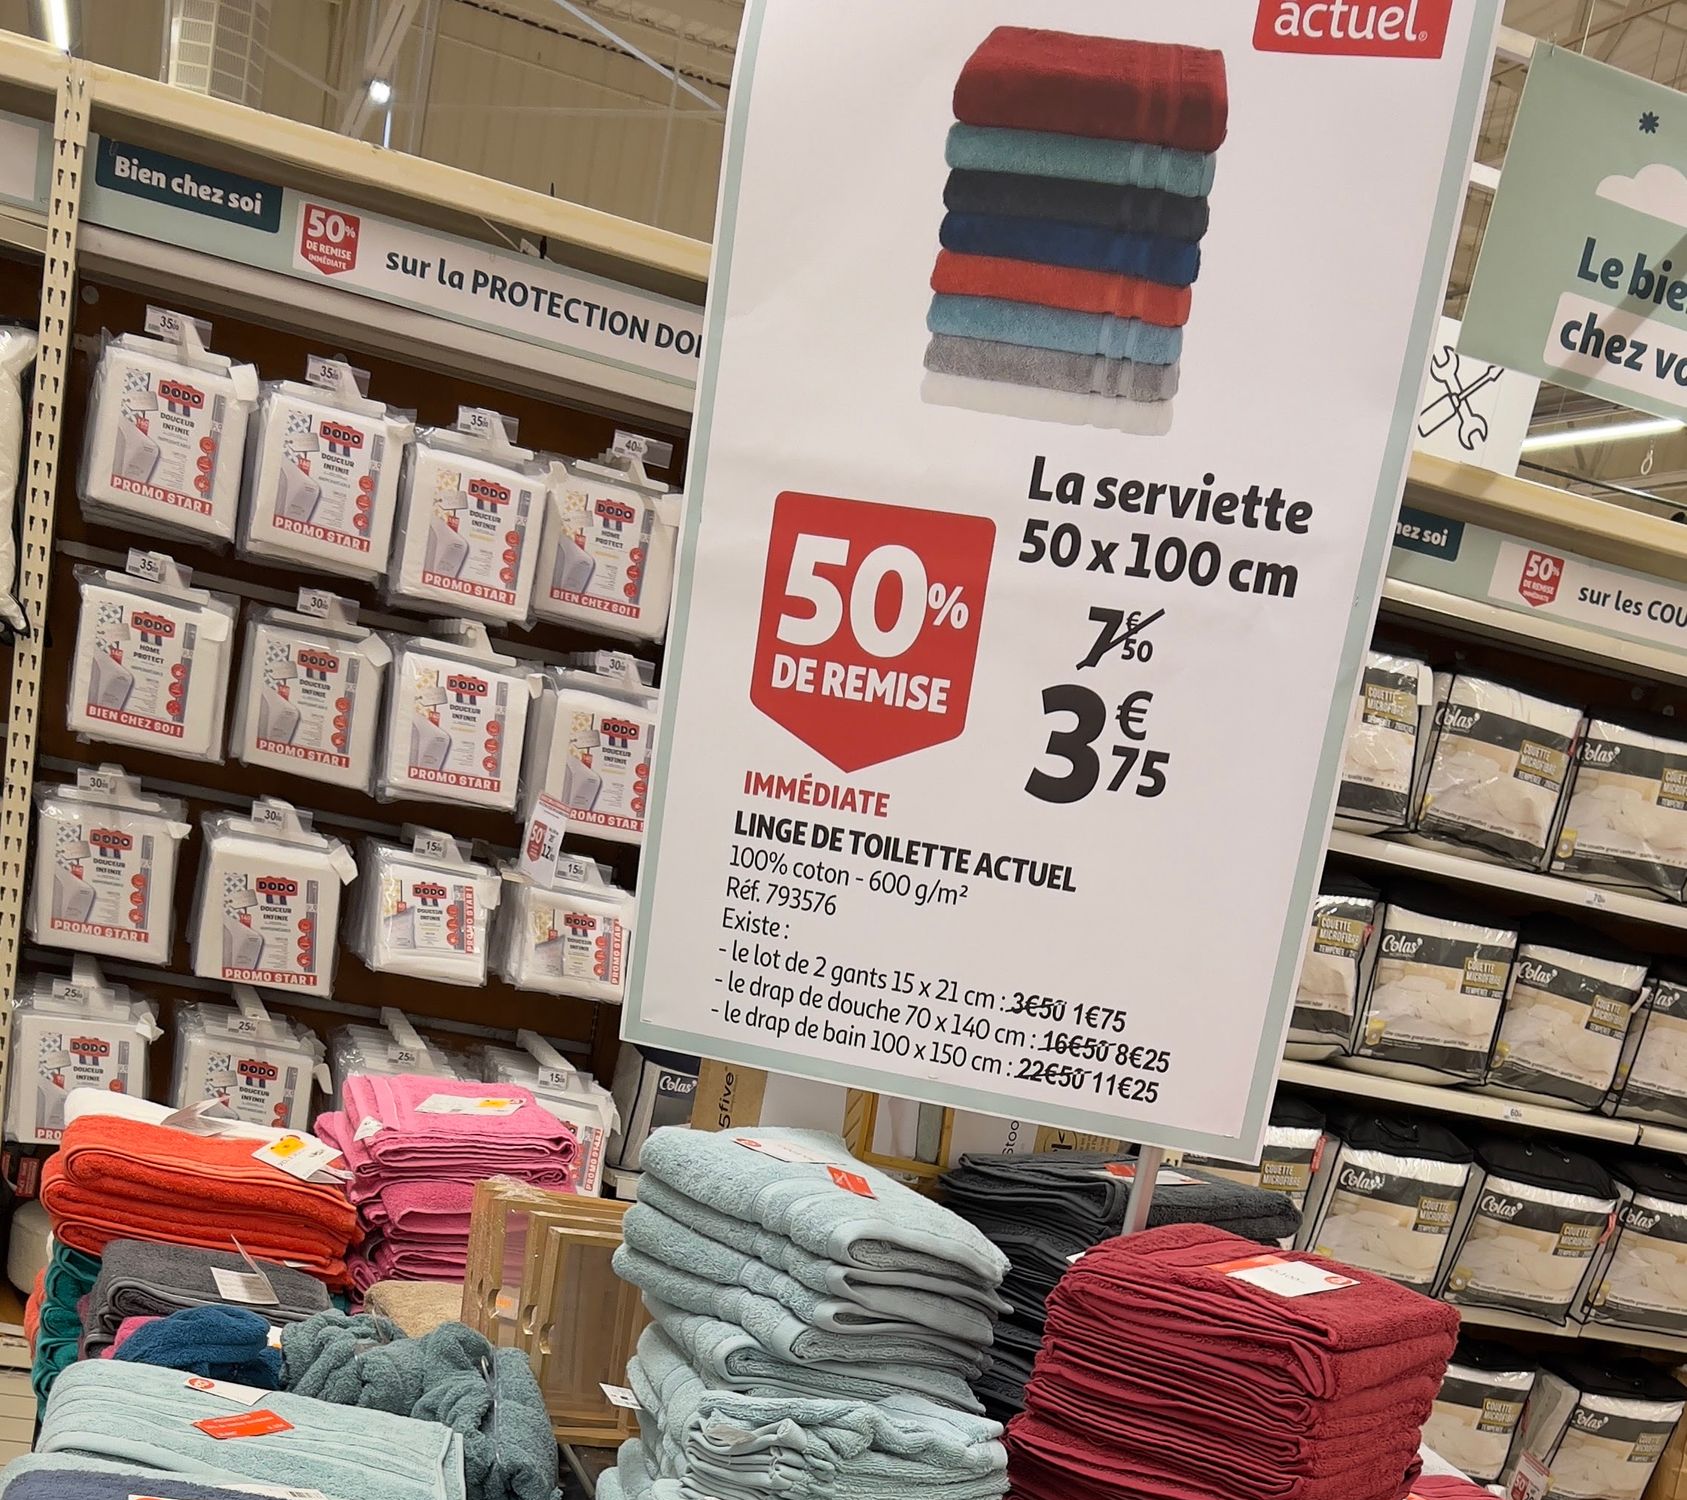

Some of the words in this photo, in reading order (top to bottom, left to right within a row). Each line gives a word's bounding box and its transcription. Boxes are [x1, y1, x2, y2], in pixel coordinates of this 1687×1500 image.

[115, 155, 166, 189] Bien
[171, 174, 224, 205] chez
[228, 193, 263, 216] soi
[307, 209, 356, 244] 50%
[306, 240, 318, 252] DE
[318, 243, 352, 261] REMISE
[1577, 236, 1624, 290] Le
[1627, 252, 1687, 314] bie
[386, 251, 431, 279] sur
[438, 258, 465, 290] la
[472, 269, 650, 343] PROTECTION
[1560, 311, 1648, 372] chez
[161, 383, 202, 405] DODO
[160, 411, 195, 429] DOUCEUR
[322, 424, 362, 445] DODO
[112, 475, 165, 503] PROMO
[166, 492, 204, 513] STAR
[470, 483, 509, 501] DODO
[1028, 455, 1086, 506] La
[1093, 472, 1314, 535] serviette
[597, 502, 633, 521] DODO
[274, 515, 326, 540] PROMO
[326, 529, 363, 551] STAR
[1422, 528, 1449, 547] soi
[1018, 518, 1082, 568] 50
[1086, 539, 1120, 574] x
[1124, 532, 1222, 587] 100
[1229, 558, 1299, 599] cm
[424, 573, 472, 593] PROMO
[473, 586, 508, 604] STAR
[551, 589, 581, 604] BIEN
[581, 592, 611, 612] CHEZ
[611, 603, 632, 616] SOI
[775, 533, 969, 659] 50%
[1578, 585, 1611, 608] sur
[1614, 590, 1642, 616] les
[133, 616, 174, 634] DODO
[300, 655, 337, 670] DODO
[448, 678, 486, 694] DODO
[771, 653, 818, 694] DE
[821, 660, 951, 715] REMISE
[410, 767, 457, 785] PROMO
[458, 776, 493, 791] STAR
[744, 770, 890, 818] IMMÉDIATE
[92, 833, 130, 847] DODO
[734, 809, 809, 847] LINGE
[810, 823, 845, 853] DE
[849, 829, 972, 875] TOILETTE
[973, 852, 1079, 894] ACTUEL
[258, 881, 296, 892] DODO
[728, 844, 788, 876] 100%
[793, 855, 851, 887] coton
[868, 869, 911, 897] 600
[914, 878, 969, 907] g/m²
[414, 886, 445, 897] DODO
[726, 875, 760, 903] Réf.
[765, 882, 838, 917] 793576
[722, 906, 782, 939] Existe
[1321, 916, 1352, 932] COUETTE
[1381, 933, 1424, 954] Colas
[732, 939, 750, 963] le
[754, 943, 781, 969] lot
[785, 949, 810, 975] de
[813, 955, 827, 977] 2
[831, 962, 888, 989] gants
[891, 970, 915, 994] 15
[918, 981, 932, 998] x
[934, 978, 958, 1003] 21
[964, 989, 996, 1010] cm
[1008, 992, 1067, 1022] 3€50
[1072, 1003, 1127, 1033] 1€75
[1519, 961, 1558, 984] Colas
[727, 970, 745, 993] le
[750, 975, 795, 1008] drap
[800, 985, 823, 1008] de
[827, 990, 901, 1023] douche
[905, 1004, 932, 1029] 70
[934, 1015, 948, 1032] x
[950, 1013, 991, 1040] 140
[995, 1027, 1026, 1047] cm
[1041, 1030, 1112, 1062] 16€50
[1115, 1043, 1171, 1074] 8€25
[724, 1000, 742, 1024] le
[745, 1006, 790, 1038] drap
[795, 1015, 819, 1039] de
[823, 1020, 866, 1050] bain
[870, 1030, 911, 1056] 100
[913, 1043, 927, 1061] x
[929, 1041, 967, 1067] 150
[971, 1054, 1002, 1075] cm
[1016, 1058, 1087, 1089] 22€50
[1093, 1072, 1160, 1104] 11€25
[239, 1063, 276, 1077] DODO
[660, 1075, 697, 1094] Colas
[1480, 1195, 1523, 1218] Colas
